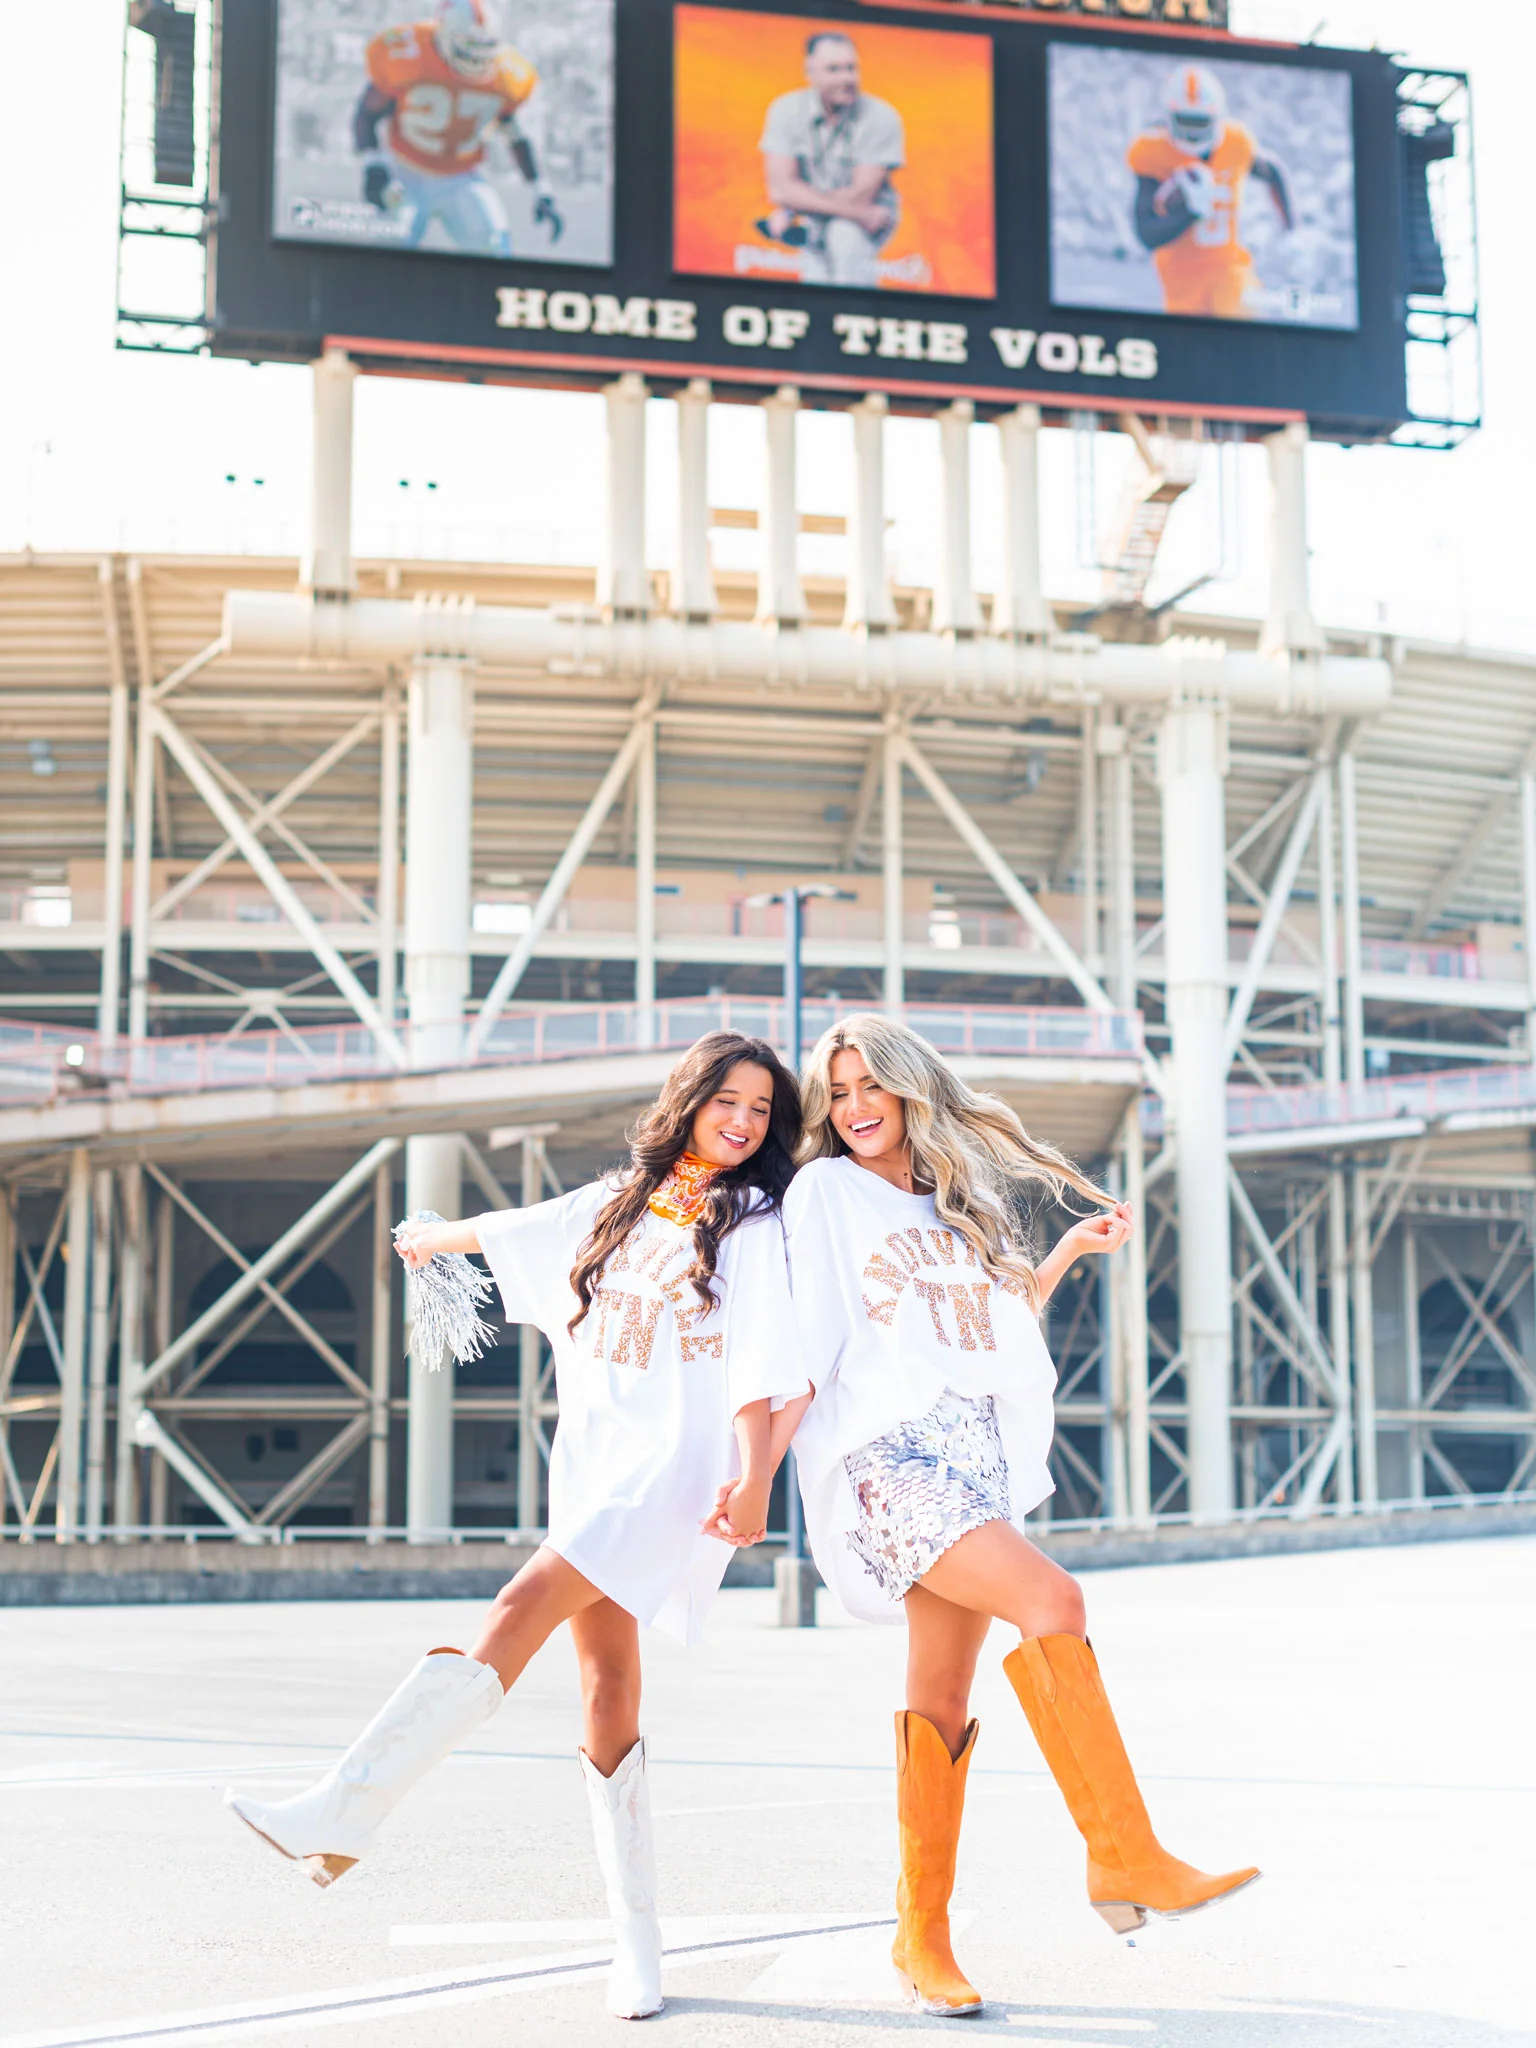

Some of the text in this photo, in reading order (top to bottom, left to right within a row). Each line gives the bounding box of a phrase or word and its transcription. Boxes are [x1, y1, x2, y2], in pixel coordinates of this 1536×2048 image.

[400, 82, 502, 154] 27
[496, 287, 1158, 379] HOME OF THE VOLS
[593, 1287, 664, 1371] TN
[913, 1277, 997, 1352] TN
